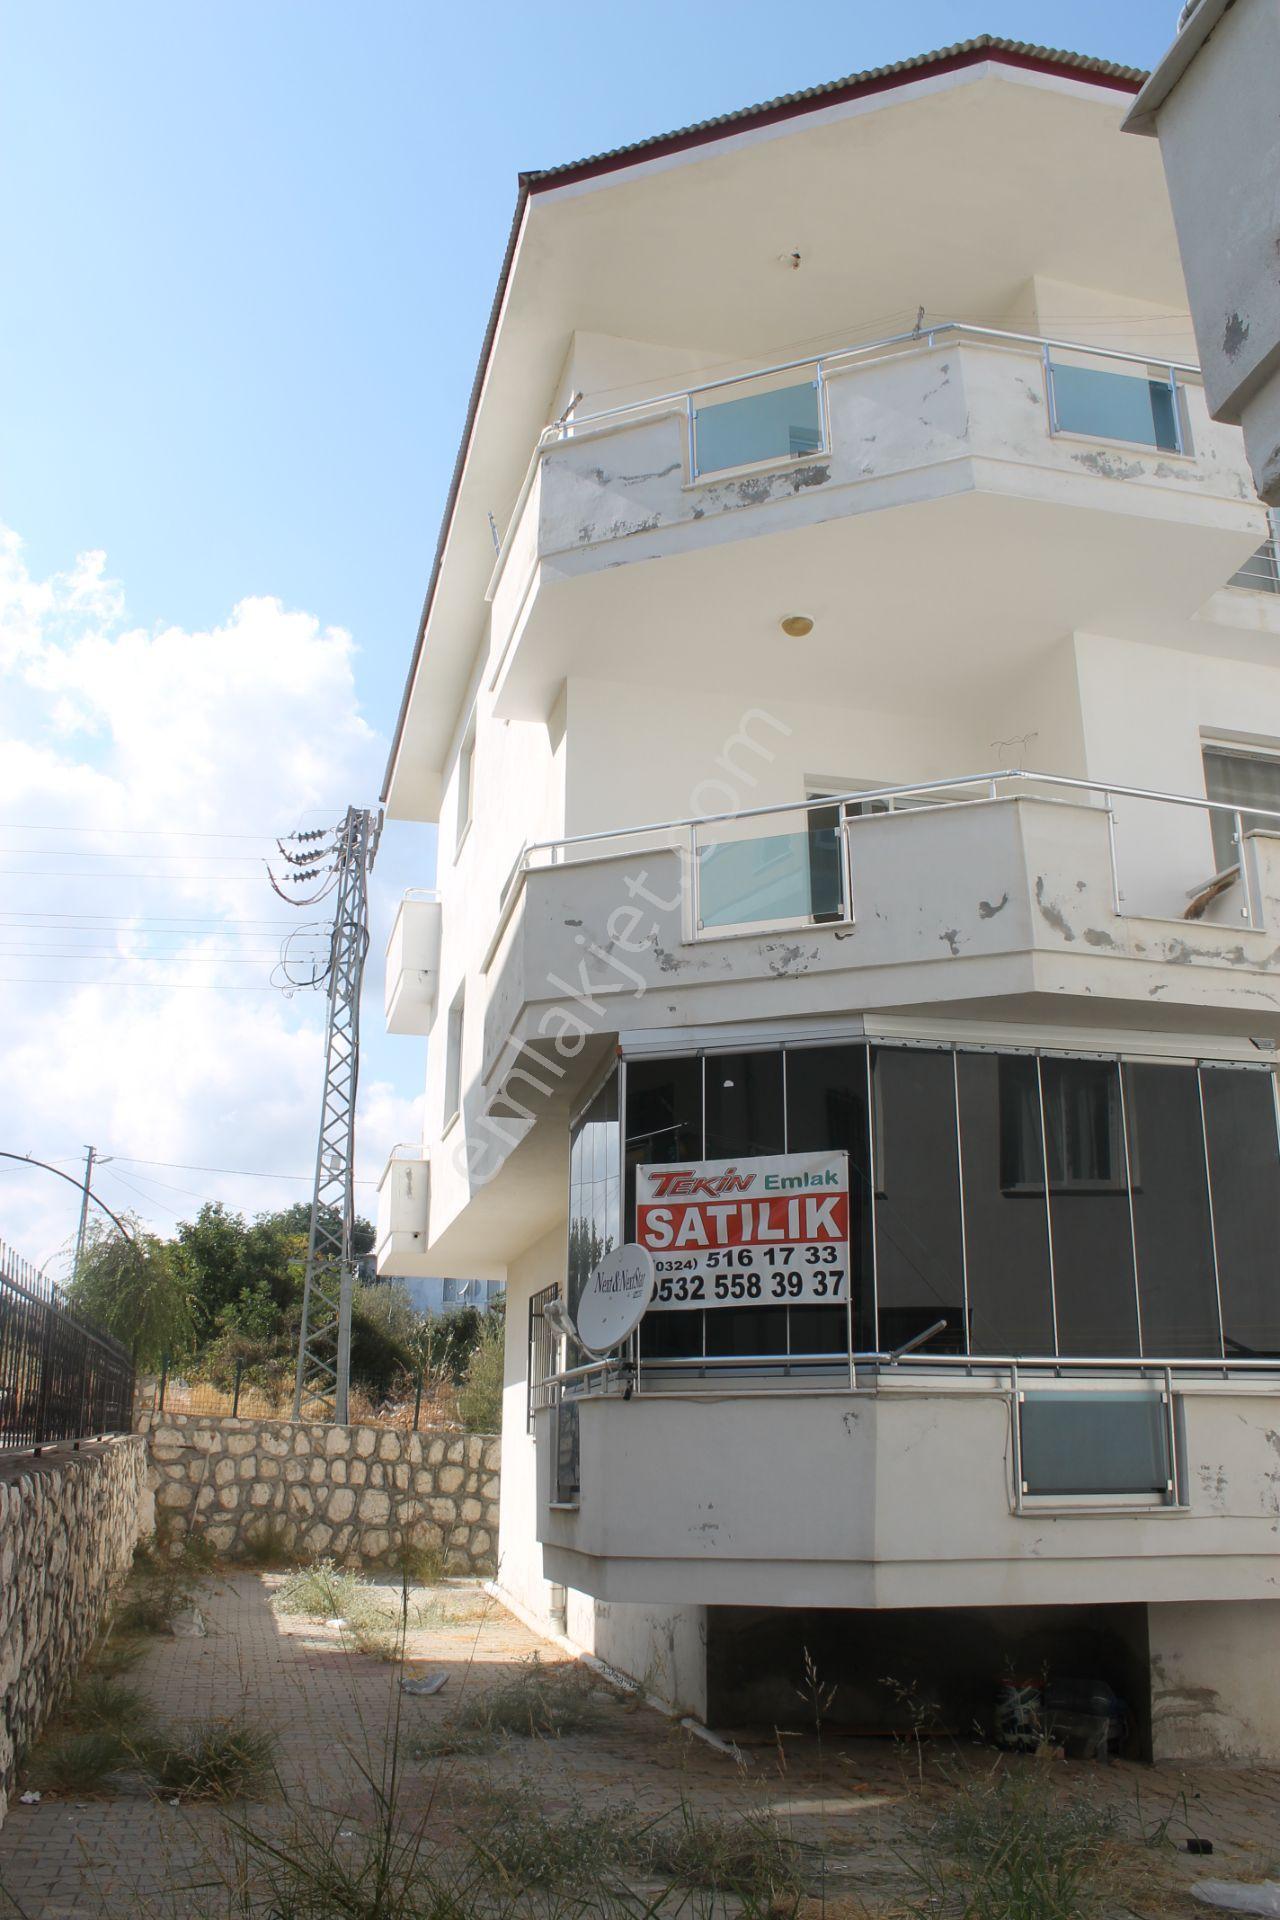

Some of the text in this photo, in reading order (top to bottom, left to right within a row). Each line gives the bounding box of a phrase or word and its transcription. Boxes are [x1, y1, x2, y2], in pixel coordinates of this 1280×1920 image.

[764, 1170, 839, 1190] Emlak
[645, 1197, 842, 1247] SATILIK
[706, 1249, 753, 1268] 516
[763, 1247, 795, 1265] 17
[805, 1246, 838, 1264] 33
[714, 1273, 761, 1299] 558
[771, 1272, 803, 1297] 39
[813, 1270, 845, 1296] 37
